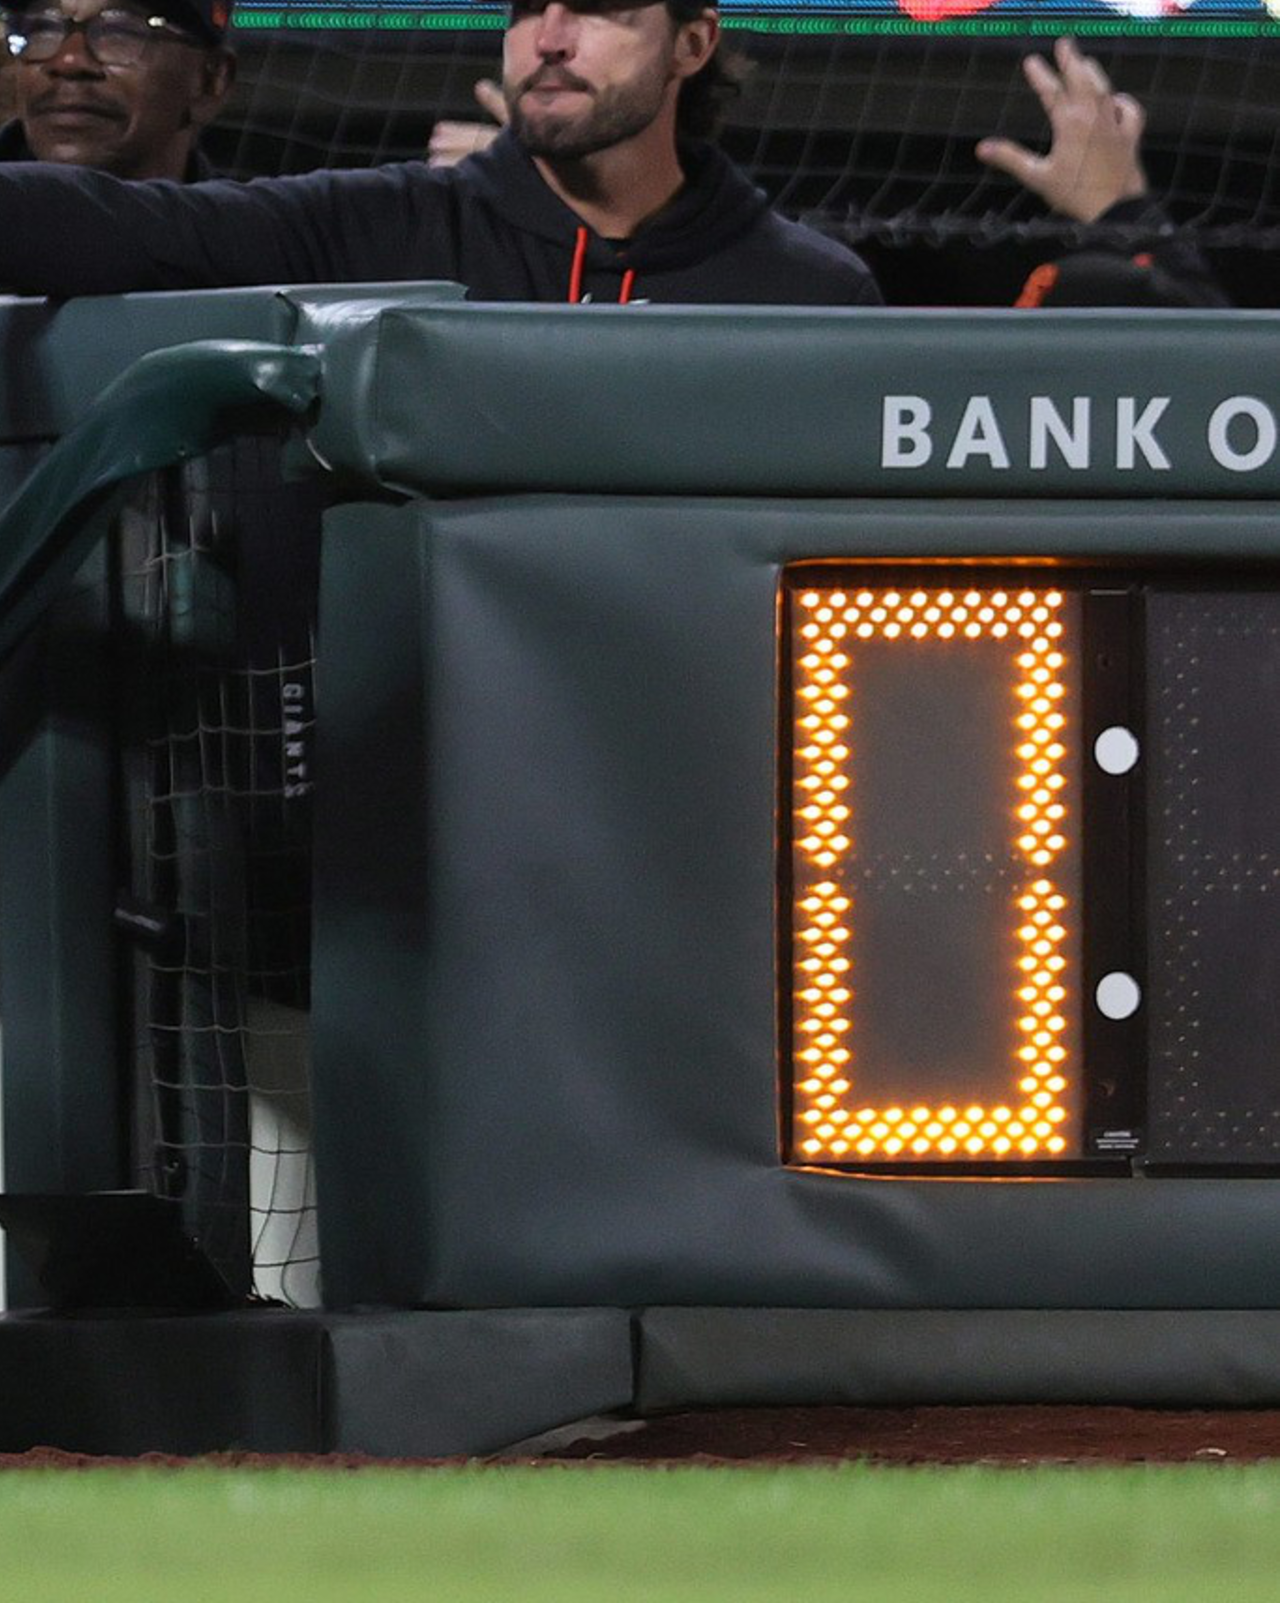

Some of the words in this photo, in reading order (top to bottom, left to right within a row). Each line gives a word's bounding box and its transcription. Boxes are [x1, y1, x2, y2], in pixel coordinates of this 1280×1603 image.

[881, 395, 1173, 470] BANK
[1208, 396, 1278, 472] O
[795, 588, 1068, 1156] 0
